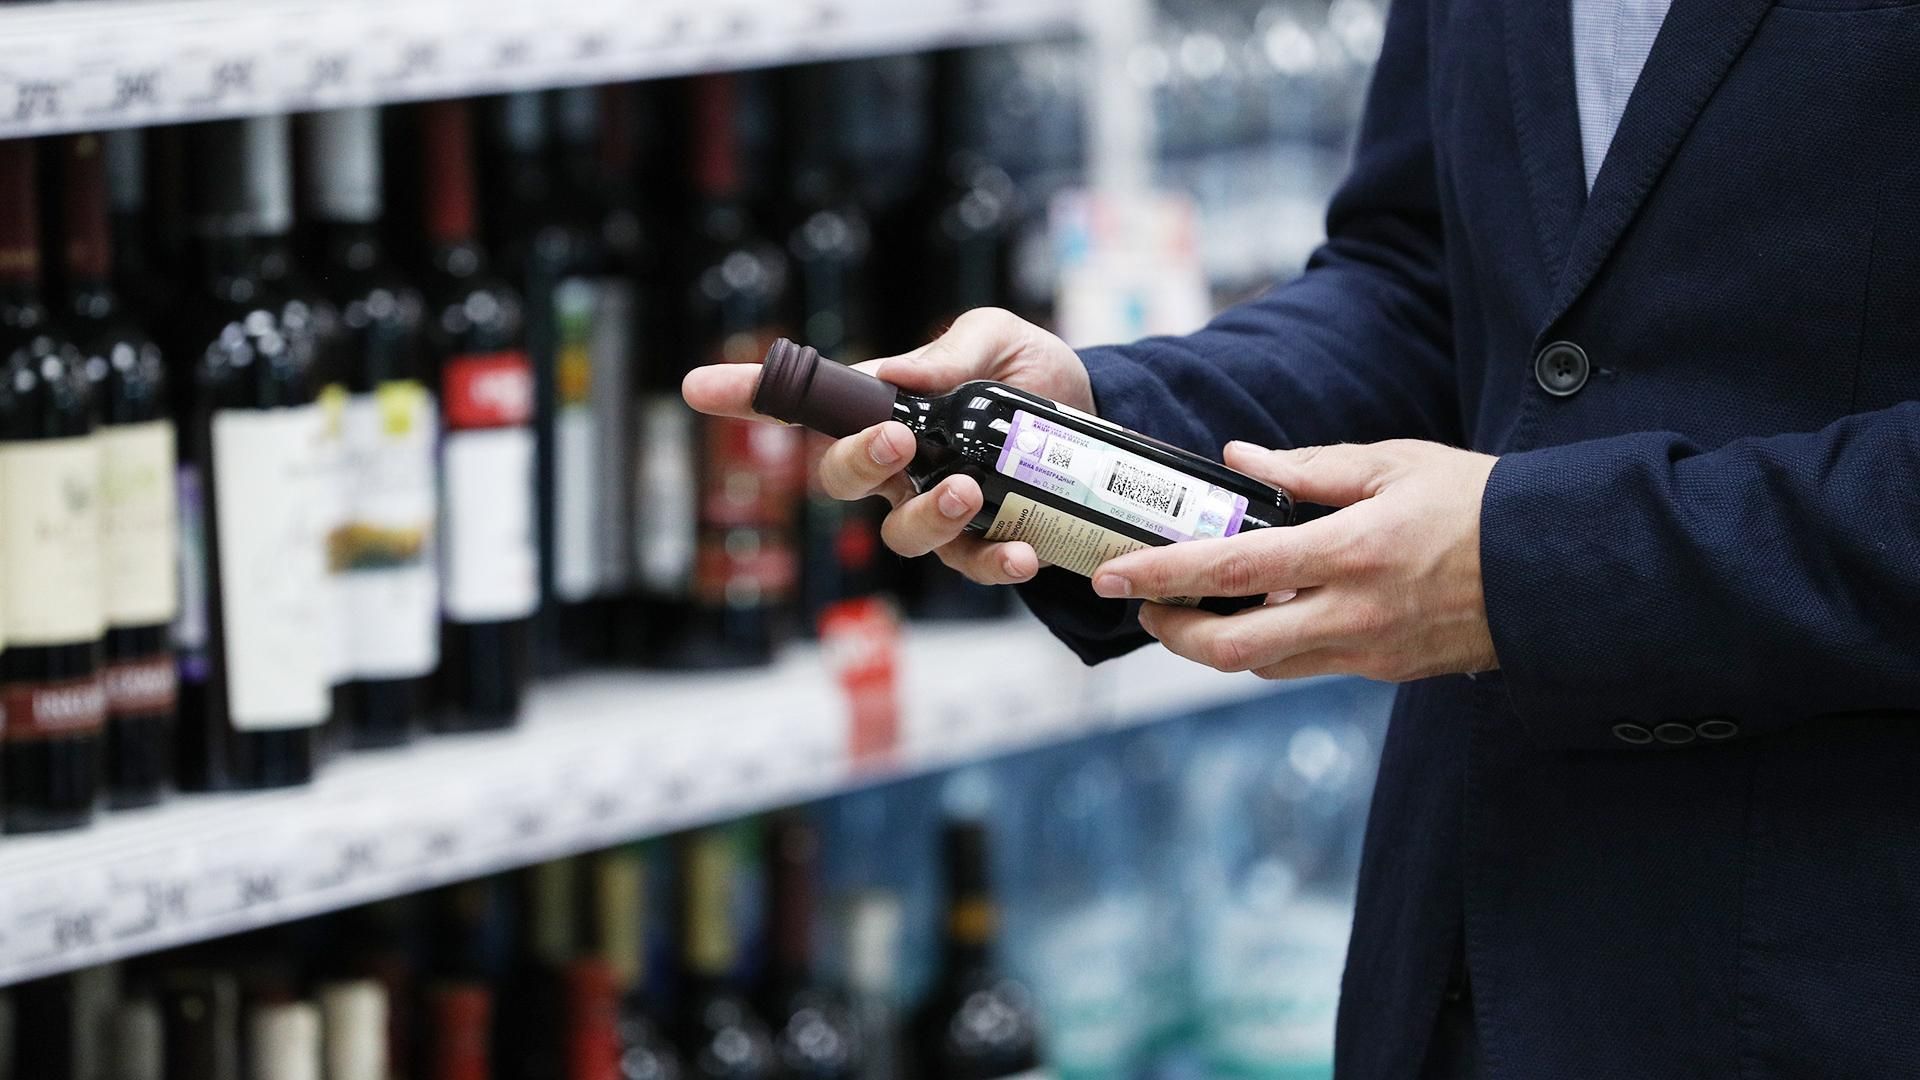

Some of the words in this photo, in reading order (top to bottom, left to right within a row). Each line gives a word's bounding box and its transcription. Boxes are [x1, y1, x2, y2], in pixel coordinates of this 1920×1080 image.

[1019, 460, 1034, 470] ВИНА
[1035, 465, 1076, 486] ВИНОГРАДНЫЕ
[1042, 480, 1065, 496] 0,375
[1110, 507, 1124, 518] 062
[1126, 513, 1163, 533] 85973610
